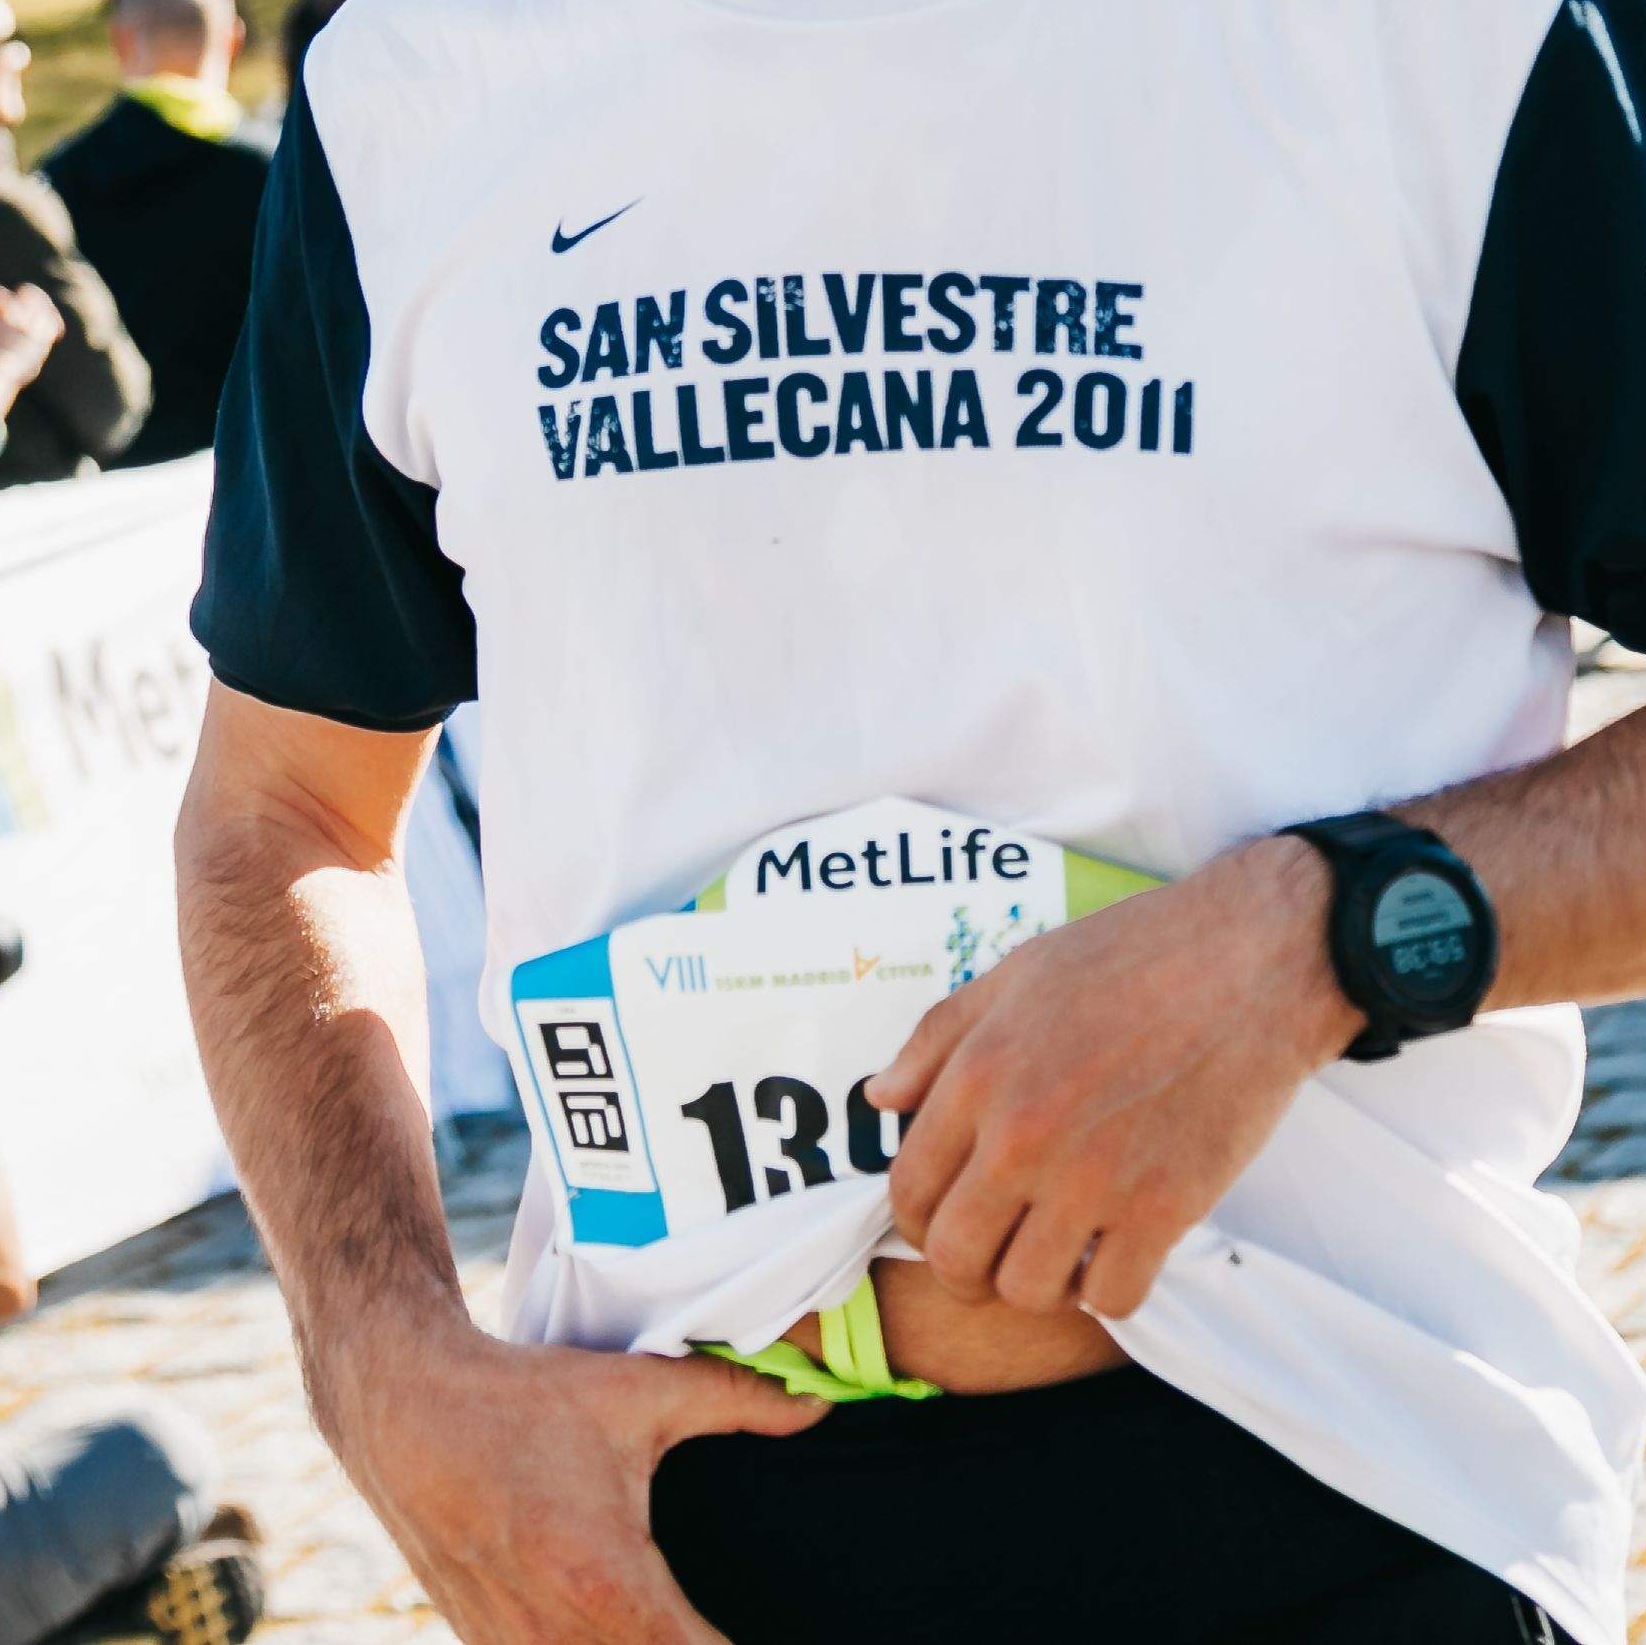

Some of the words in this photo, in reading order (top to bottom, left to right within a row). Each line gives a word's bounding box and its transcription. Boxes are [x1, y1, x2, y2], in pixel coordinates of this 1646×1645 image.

[538, 289, 686, 388] SAN
[702, 272, 1144, 364] SILVESTRE
[538, 369, 990, 481] VALLECANA
[1015, 368, 1194, 454] 2011
[757, 828, 1029, 894] MetLife
[645, 955, 707, 993] VIII
